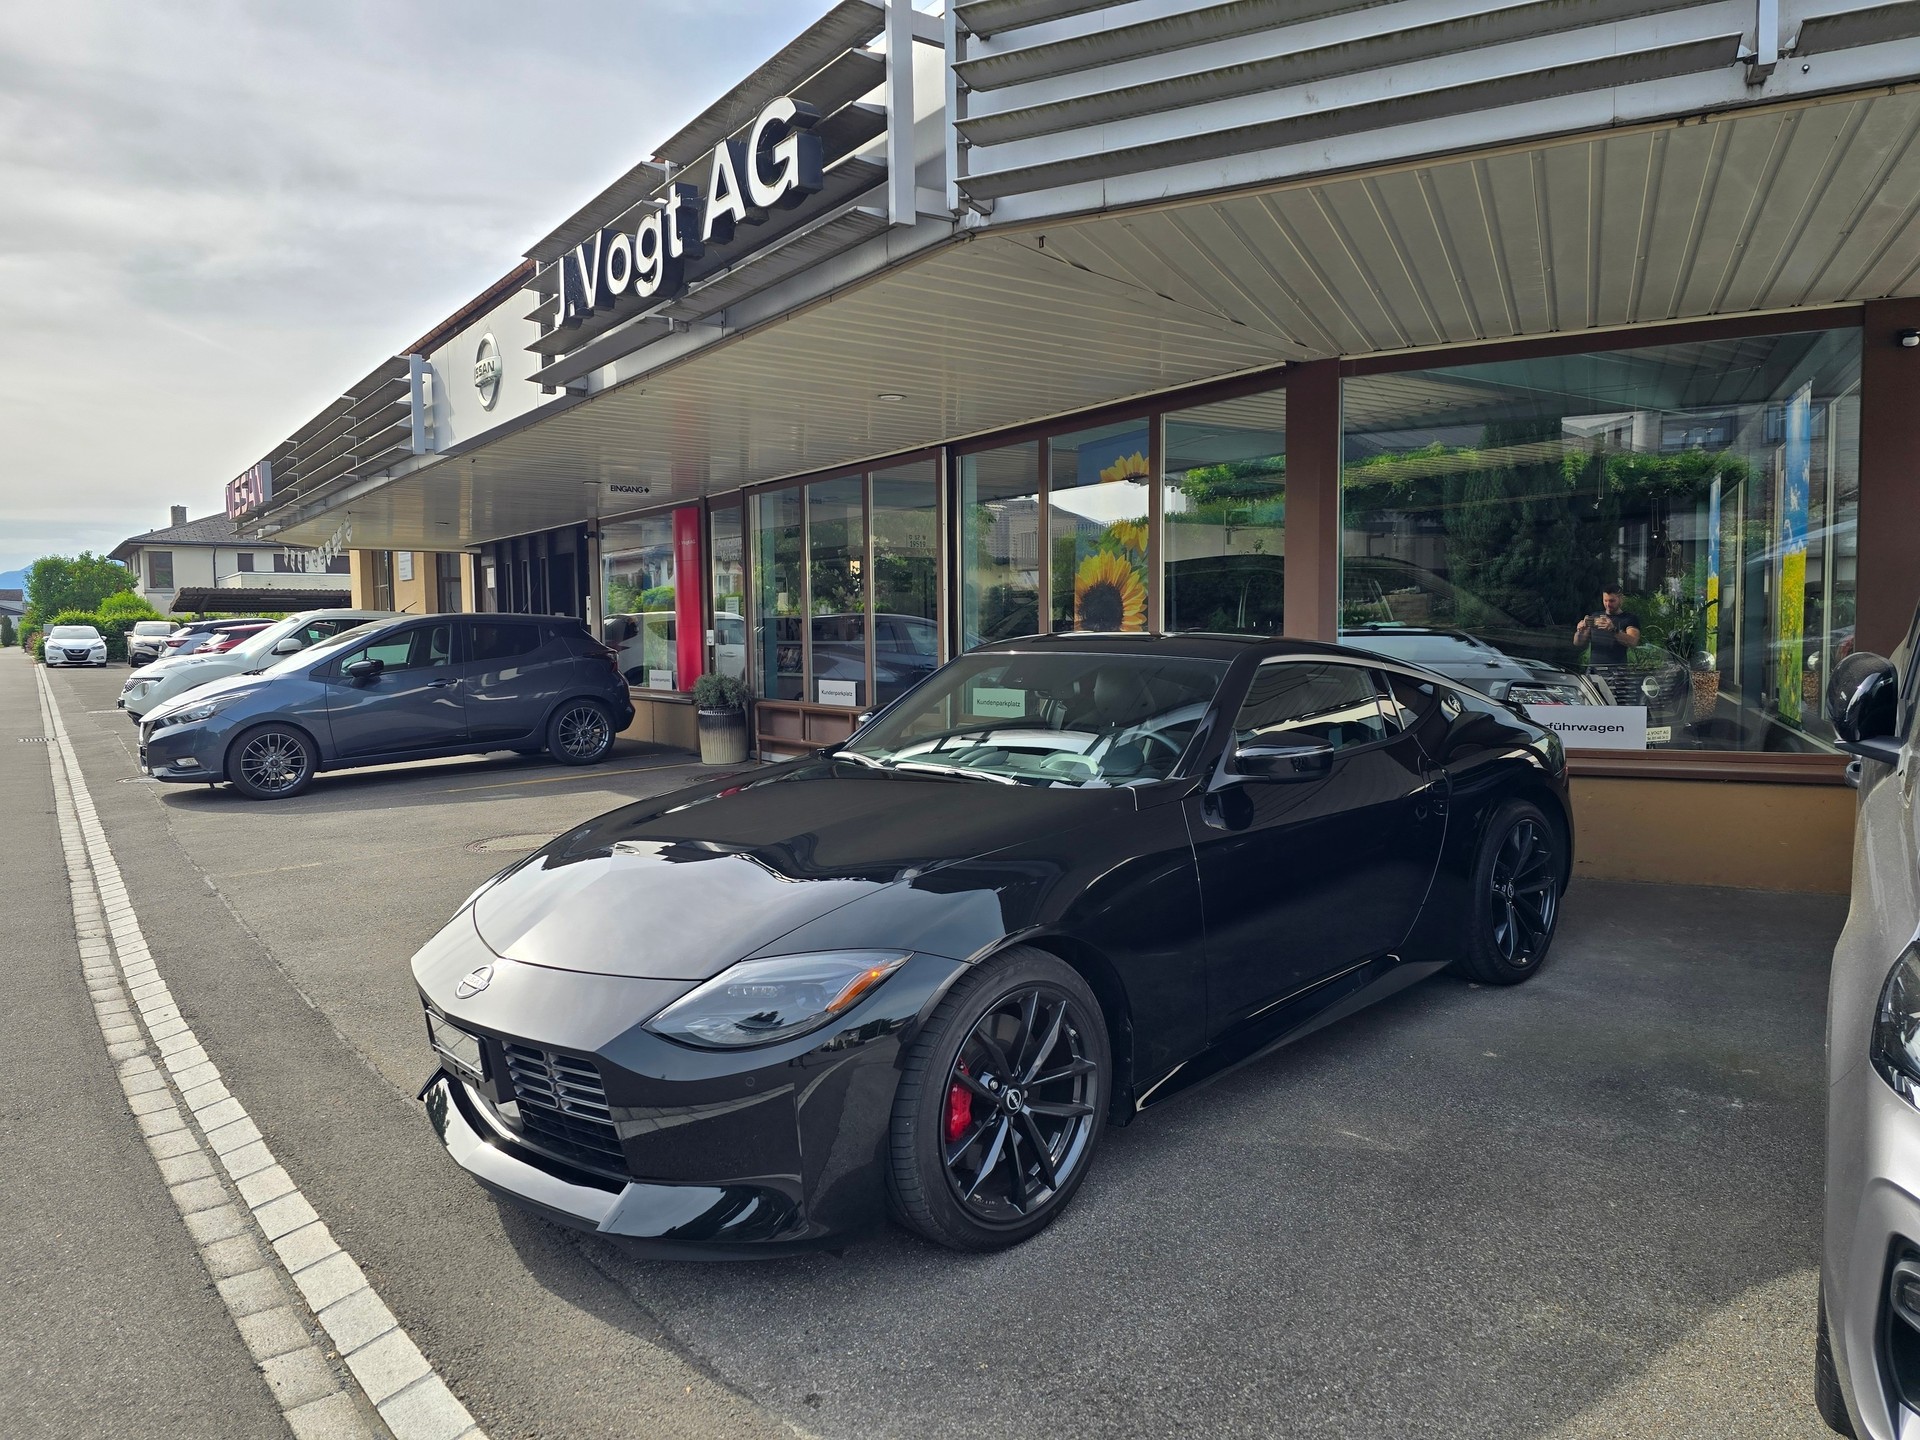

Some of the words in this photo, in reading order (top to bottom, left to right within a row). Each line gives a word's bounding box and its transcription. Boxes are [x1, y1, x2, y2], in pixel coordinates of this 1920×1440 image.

[701, 95, 800, 242] AG
[610, 484, 644, 494] EINGANG
[976, 699, 1021, 707] Kundenparkplatz
